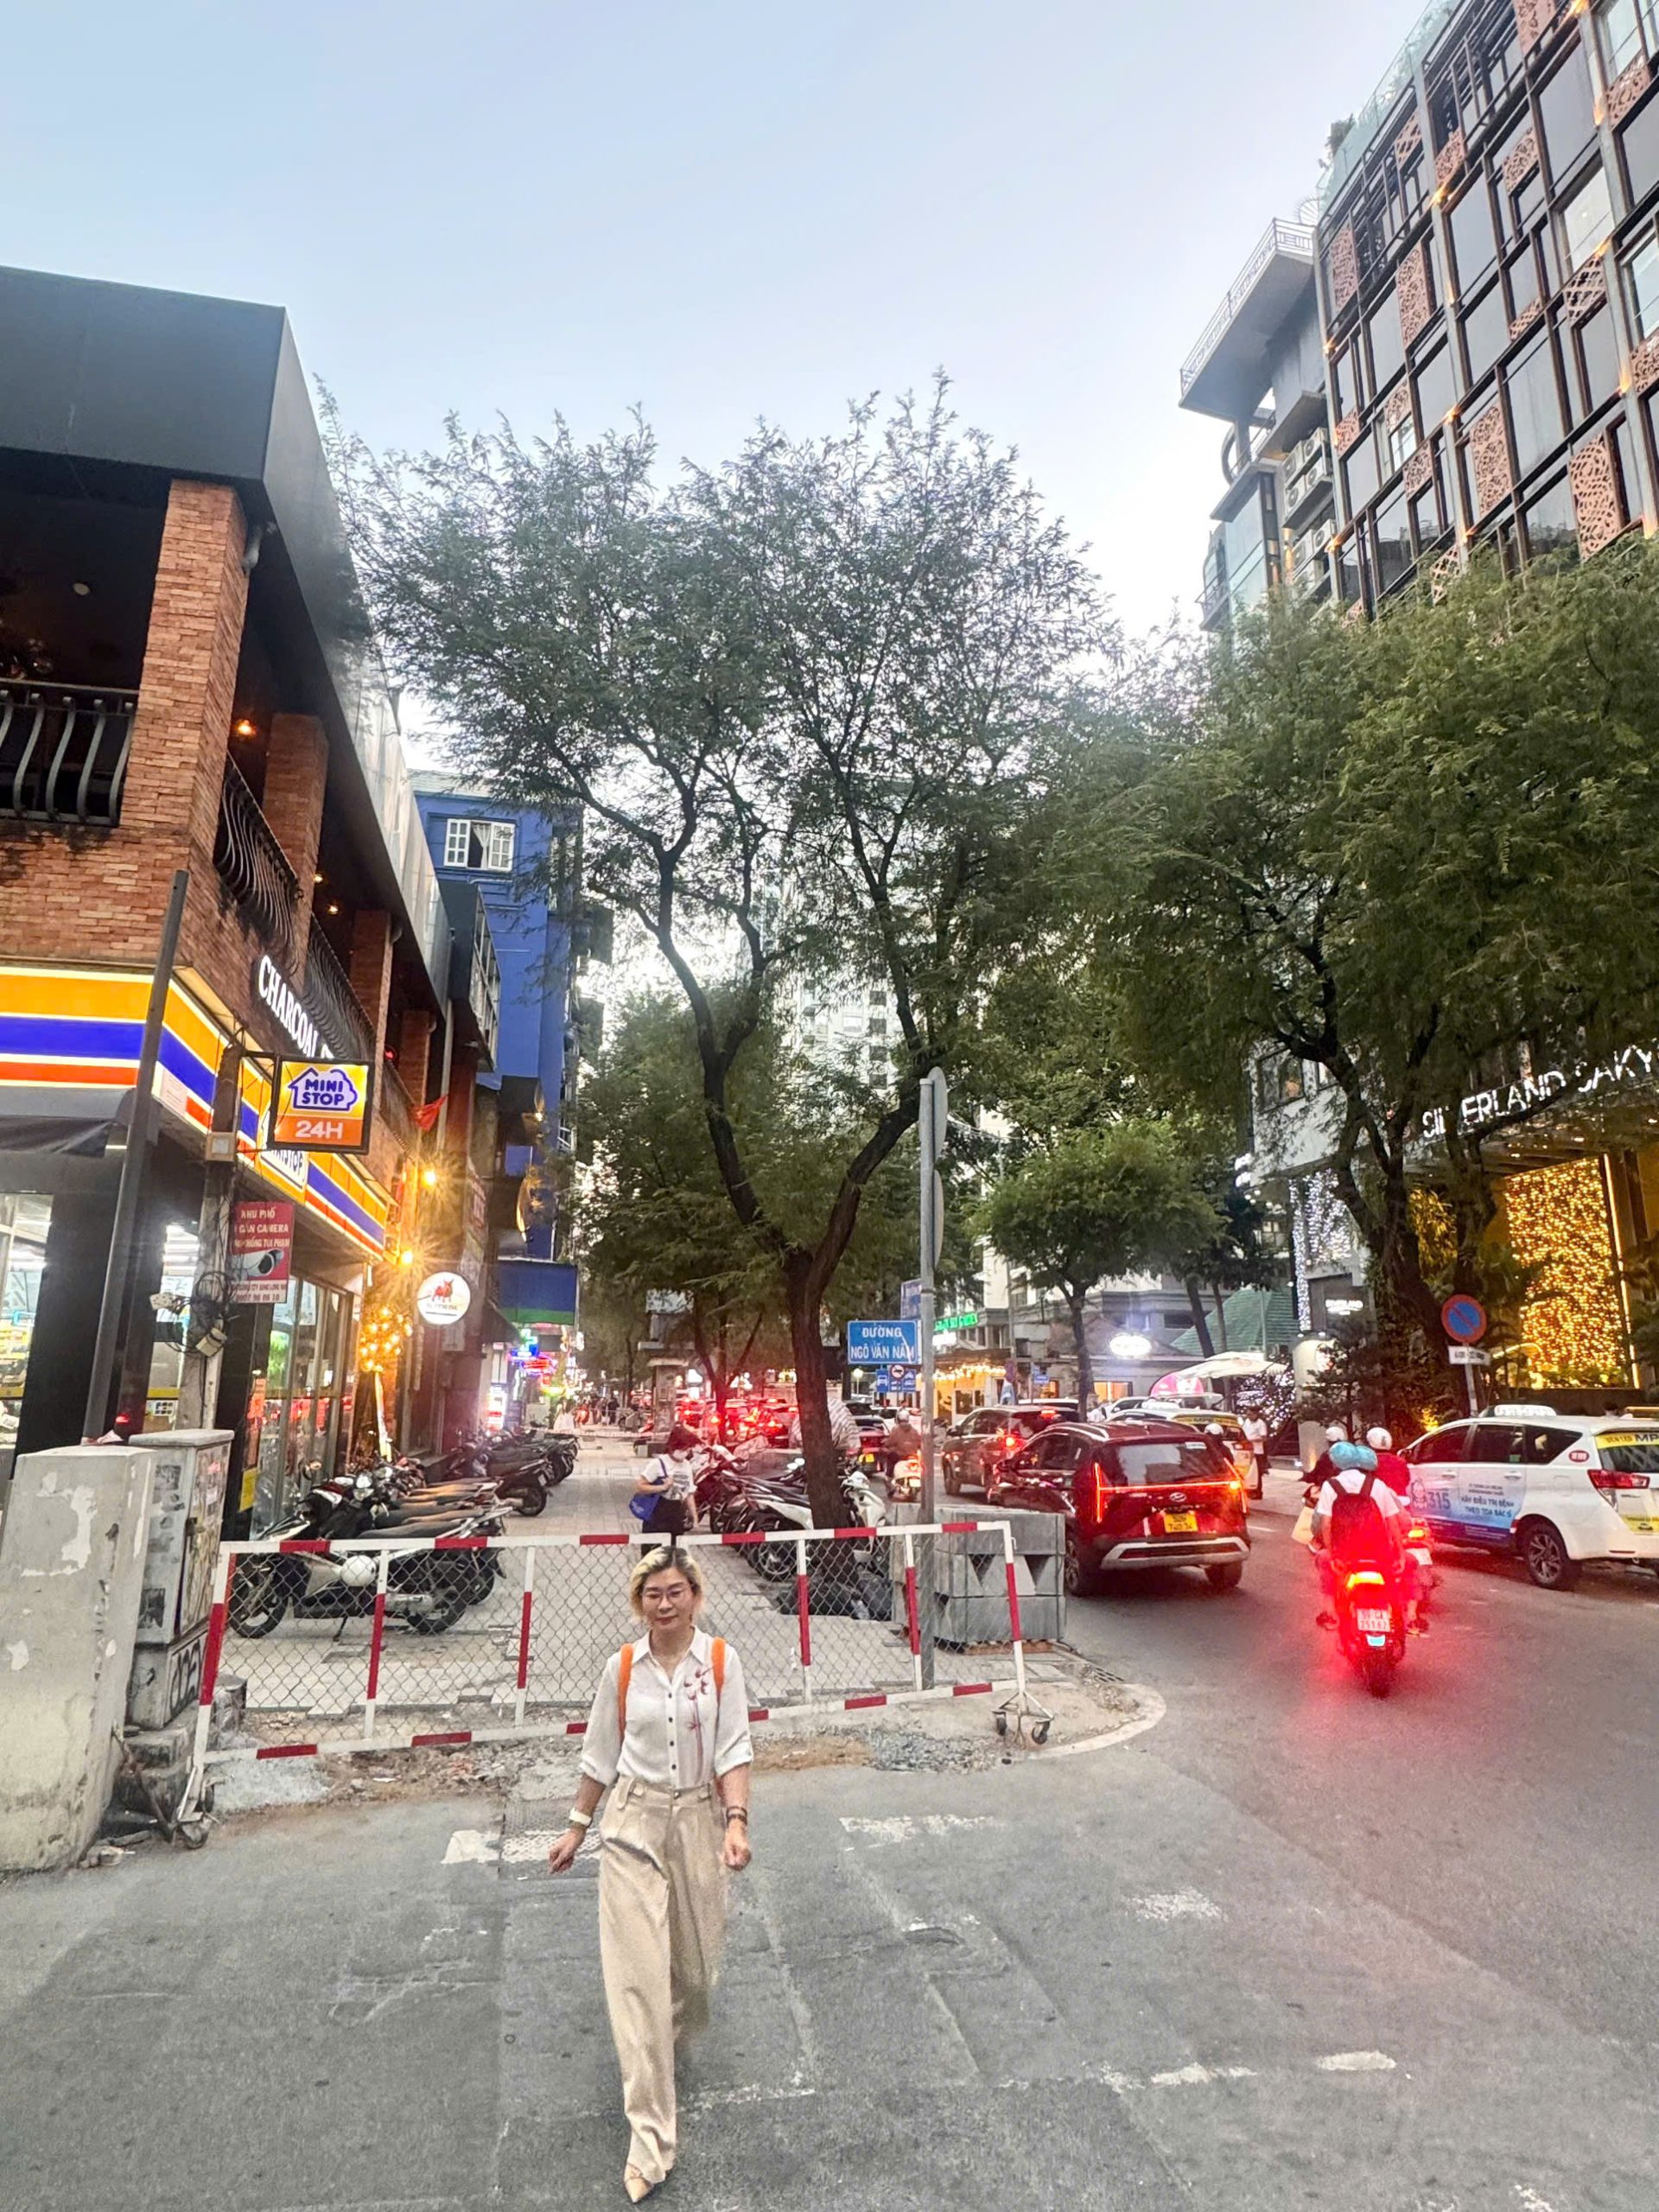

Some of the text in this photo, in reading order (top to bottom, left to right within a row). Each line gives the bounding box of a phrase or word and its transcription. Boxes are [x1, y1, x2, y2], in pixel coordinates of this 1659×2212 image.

[304, 1078, 344, 1093] MINI
[1422, 1042, 1659, 1137] SILERLAND SAKY
[302, 1091, 345, 1106] STOP
[295, 1120, 344, 1140] 24H
[861, 1325, 903, 1338] ĐƯỜNG
[850, 1343, 869, 1359] NGÔ
[1427, 1492, 1452, 1510] 315
